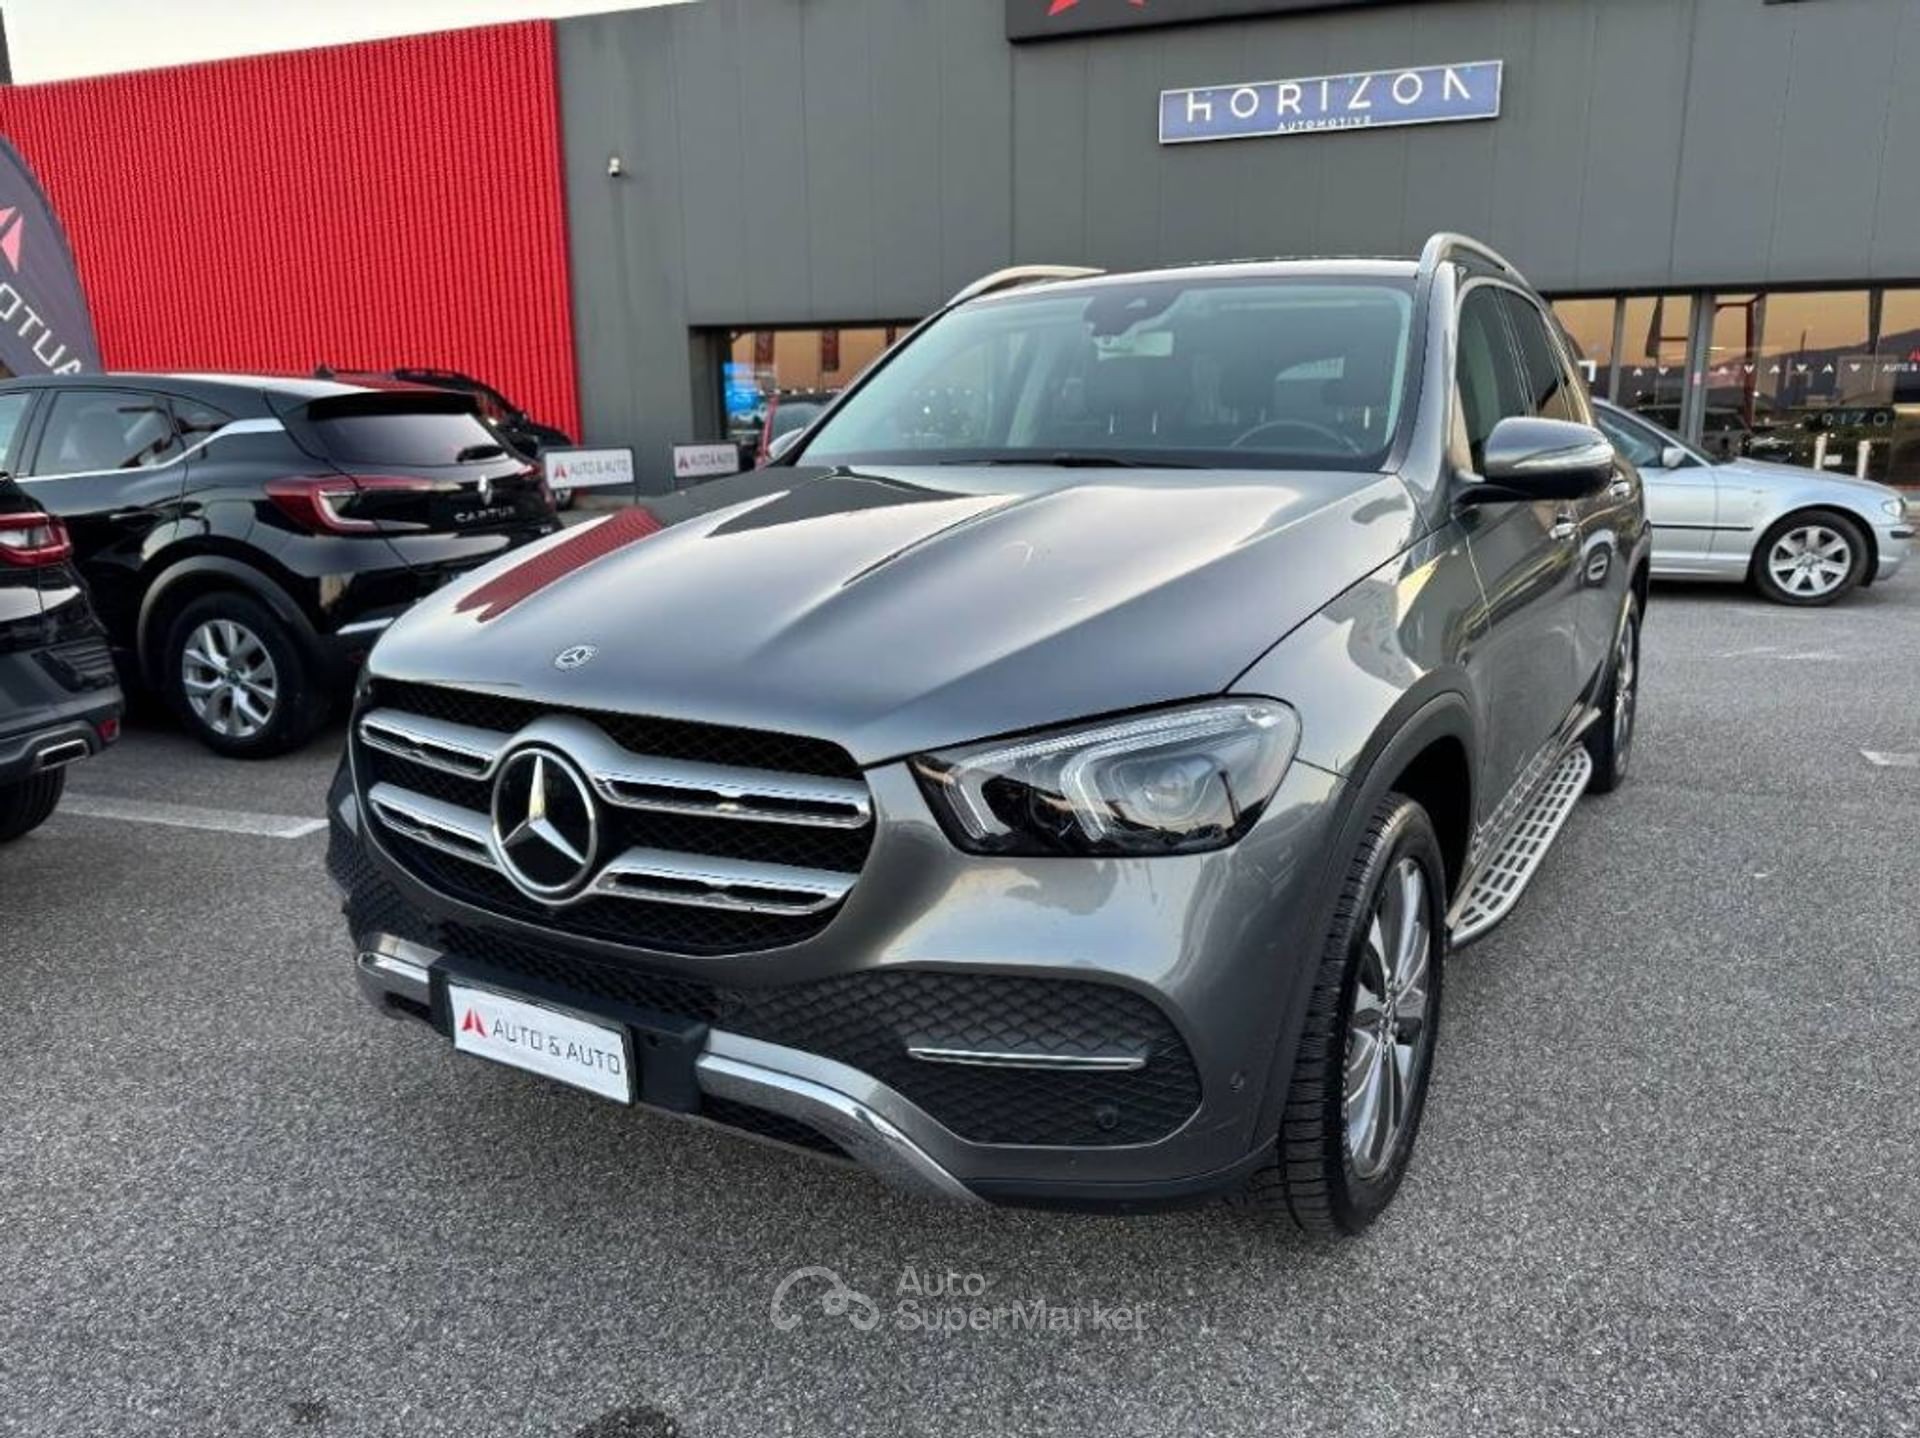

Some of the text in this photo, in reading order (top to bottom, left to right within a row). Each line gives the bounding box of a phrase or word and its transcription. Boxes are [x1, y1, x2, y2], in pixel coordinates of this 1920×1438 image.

[1187, 68, 1471, 122] HORIZON
[1278, 115, 1373, 131] AUTOMOTIVE
[569, 461, 595, 476] AUTO
[605, 458, 630, 473] AUTO
[454, 506, 515, 522] CAPTUR
[493, 1018, 621, 1075] AUTO & AUTO
